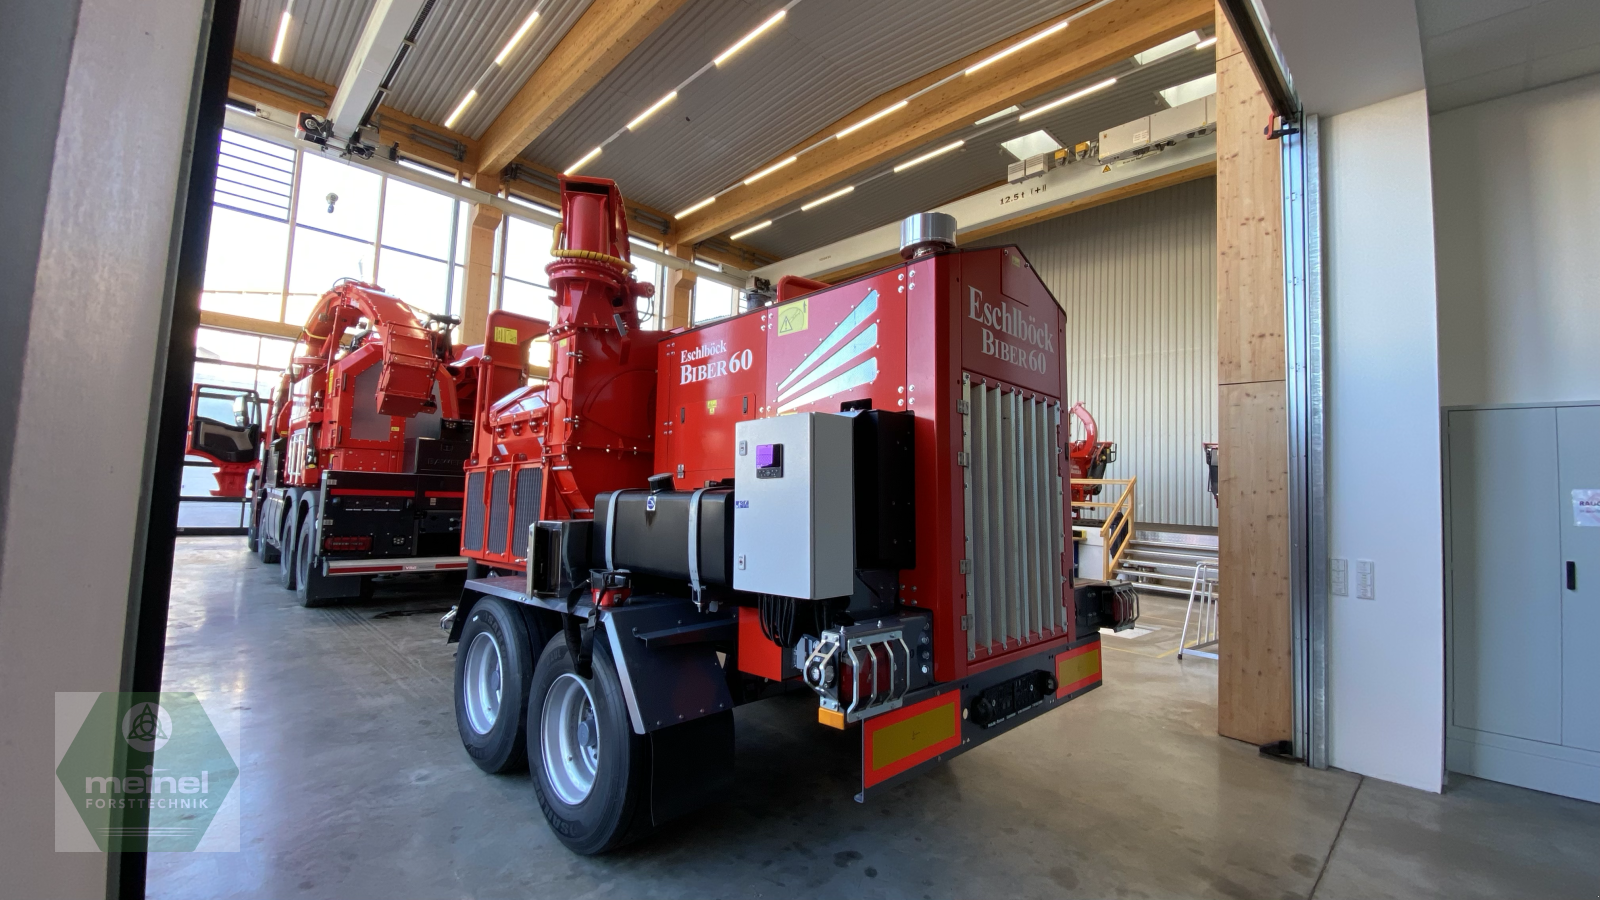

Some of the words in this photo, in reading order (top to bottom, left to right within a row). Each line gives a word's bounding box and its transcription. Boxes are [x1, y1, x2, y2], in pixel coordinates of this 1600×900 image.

[1000, 193, 1019, 205] 12.5
[968, 285, 1055, 353] Eschlböck
[680, 340, 727, 363] Eschlböck
